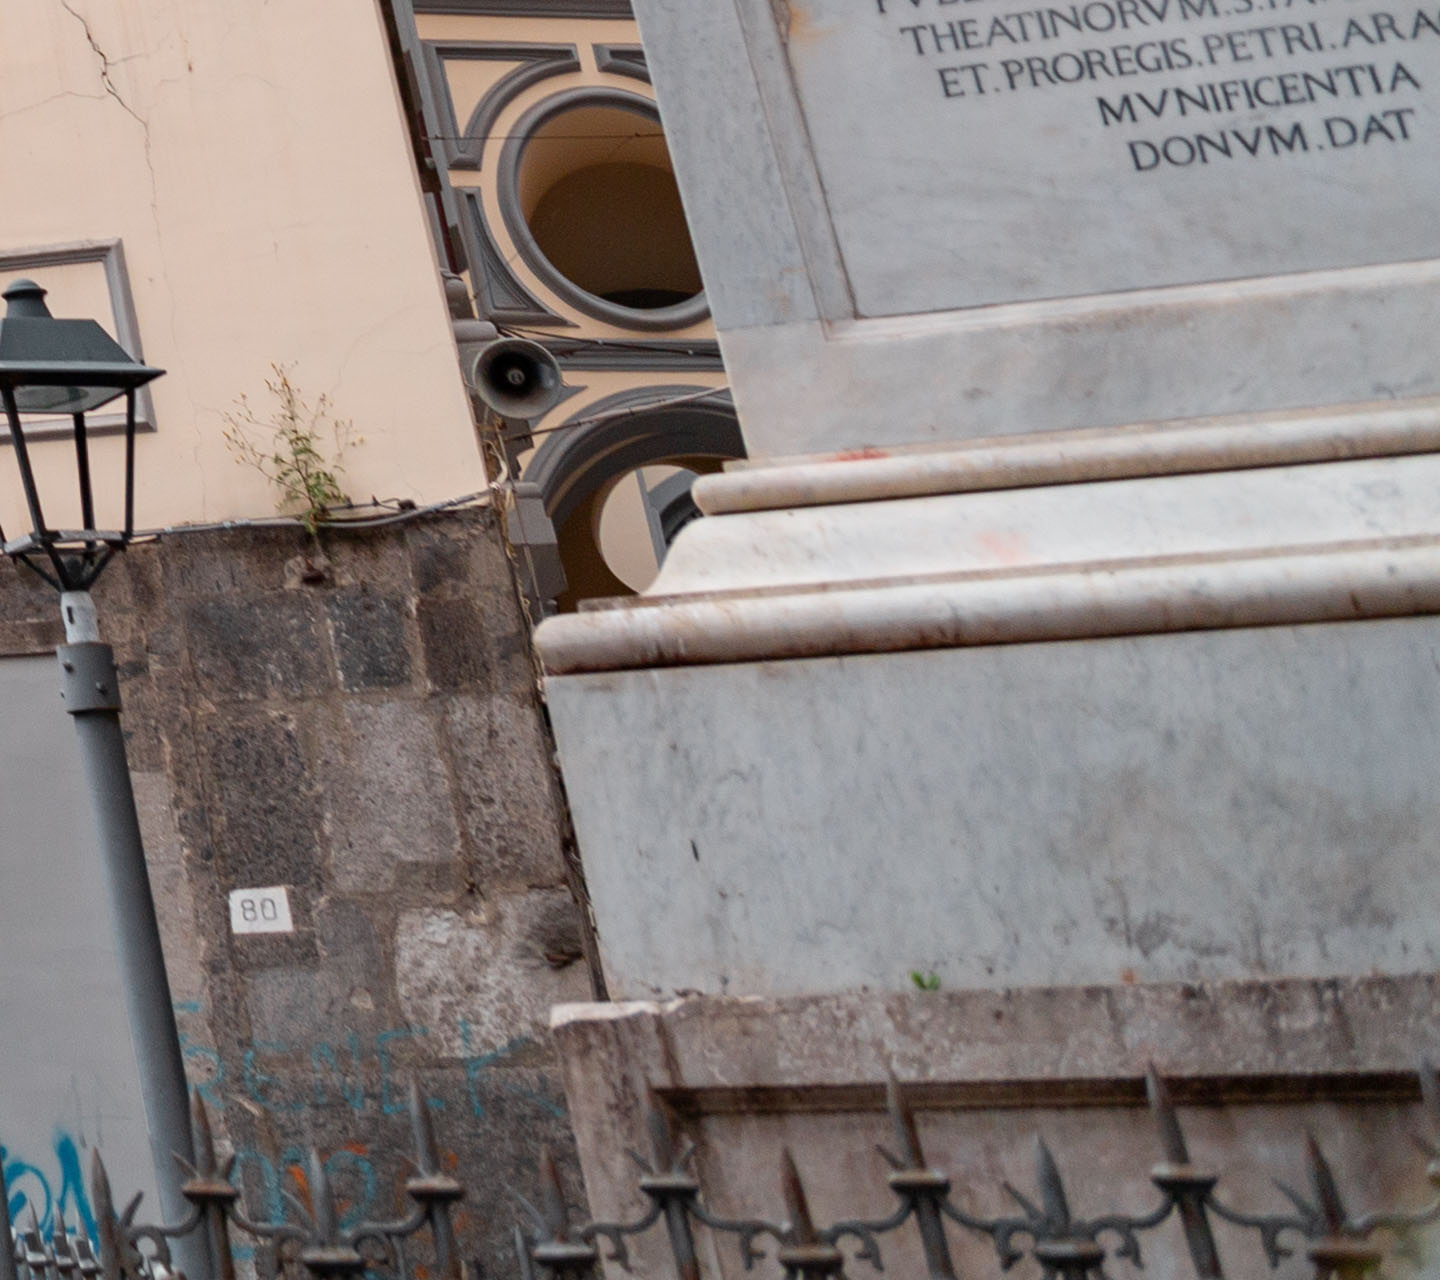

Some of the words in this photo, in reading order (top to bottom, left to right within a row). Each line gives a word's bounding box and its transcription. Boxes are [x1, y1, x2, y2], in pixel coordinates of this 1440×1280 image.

[1342, 9, 1440, 48] ARA
[1097, 63, 1420, 126] MVNIFICENTIA
[1324, 108, 1414, 148] DAT
[241, 897, 277, 922] 80
